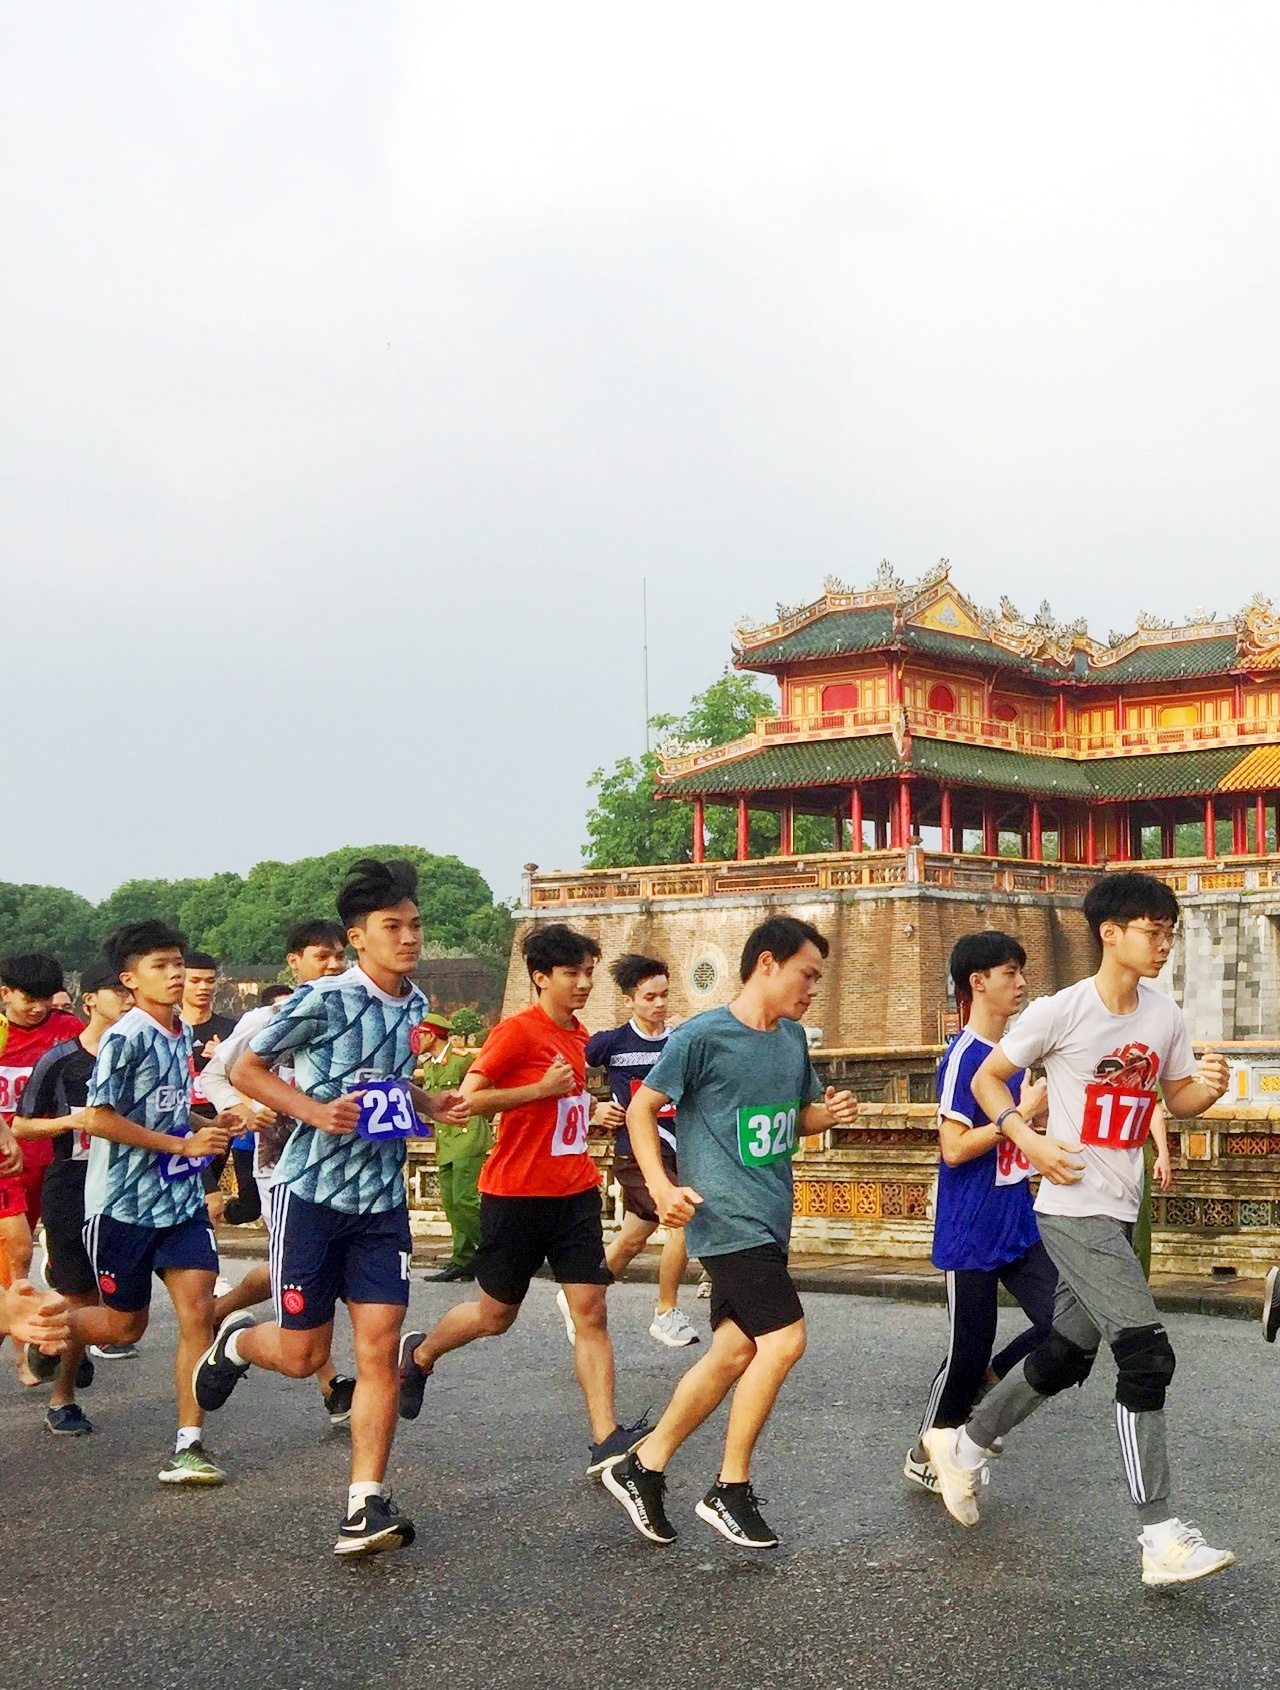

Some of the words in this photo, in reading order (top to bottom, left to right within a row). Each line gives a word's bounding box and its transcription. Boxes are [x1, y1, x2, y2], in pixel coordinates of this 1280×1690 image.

[362, 1087, 419, 1134] 231
[748, 1107, 796, 1158] 320
[1095, 1093, 1151, 1141] 177
